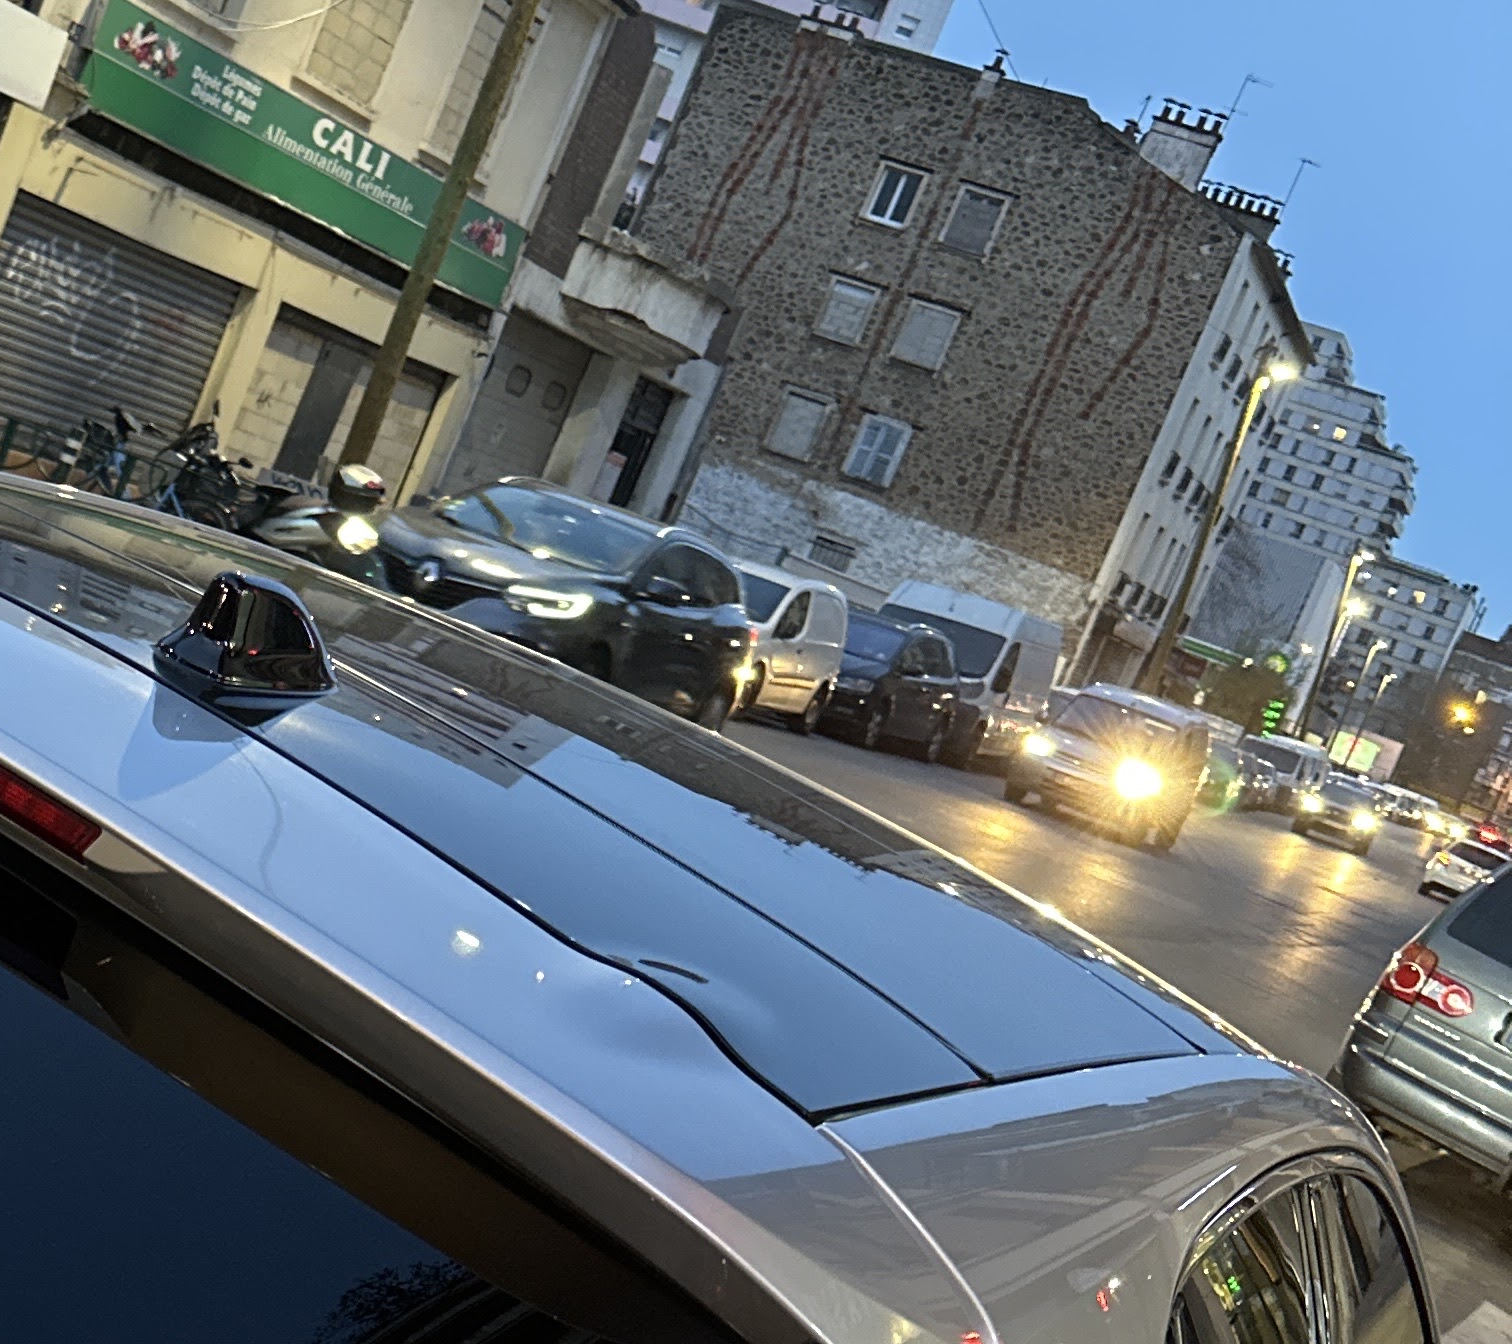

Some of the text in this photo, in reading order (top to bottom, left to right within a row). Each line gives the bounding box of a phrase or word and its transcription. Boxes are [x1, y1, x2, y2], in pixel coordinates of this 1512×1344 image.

[261, 123, 414, 216] Alimentation Générale
[311, 117, 391, 181] CALI
